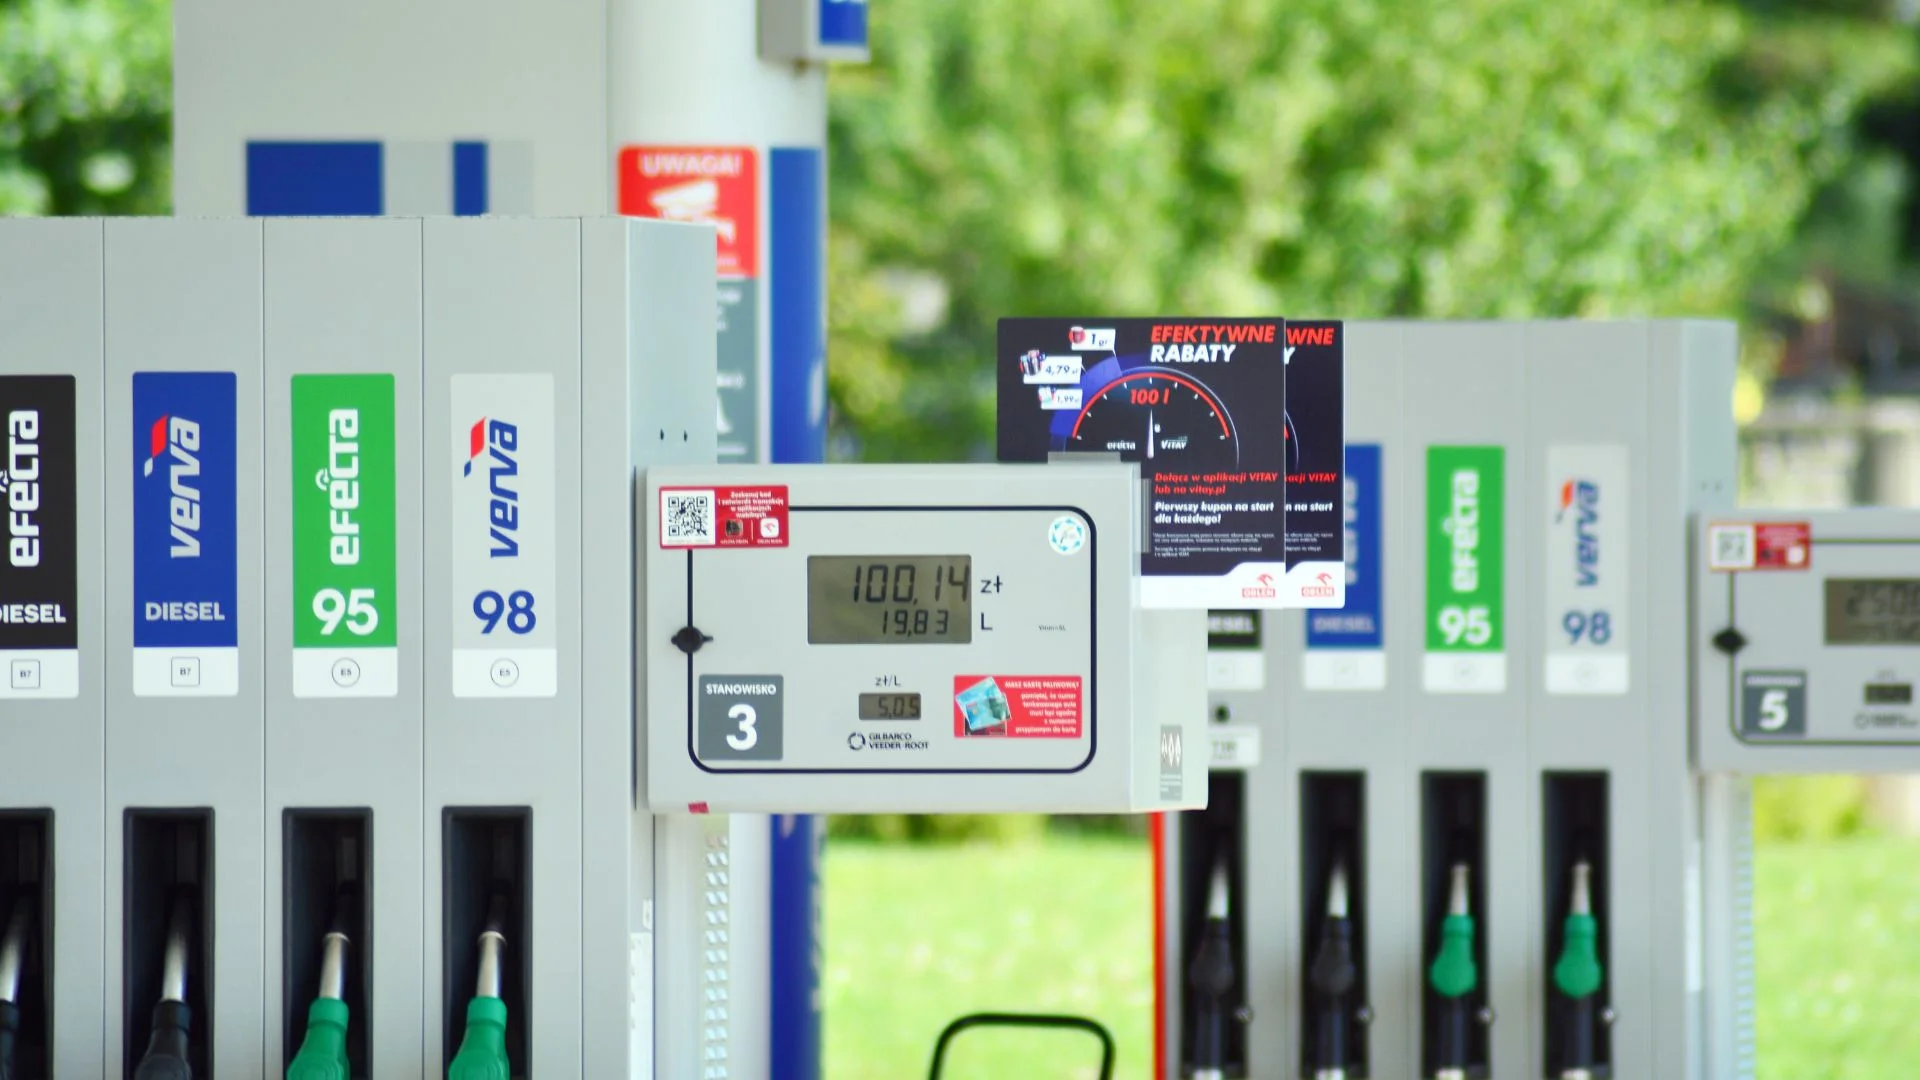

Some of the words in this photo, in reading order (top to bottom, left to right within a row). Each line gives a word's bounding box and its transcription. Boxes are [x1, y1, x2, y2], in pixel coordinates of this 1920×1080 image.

[641, 155, 741, 175] UWAGA!
[1091, 333, 1096, 345] 1
[1151, 325, 1276, 343] EFEKTYWNE
[1151, 344, 1236, 363] RABATY
[1045, 364, 1070, 376] 4,79
[1130, 388, 1159, 405] 100
[1191, 474, 1201, 482] w
[1203, 472, 1247, 484] aplikacji
[1249, 472, 1279, 482] VITAY
[1308, 472, 1337, 482] VITAY
[169, 416, 201, 559] verva
[488, 418, 519, 559] verva
[1155, 484, 1171, 494] lub
[1173, 486, 1187, 494] na
[1189, 484, 1226, 496] vitay.pl
[1155, 501, 1199, 514] Pierwszy
[1201, 501, 1233, 514] kupon
[1234, 503, 1249, 512] na
[1250, 501, 1275, 512] start
[1294, 503, 1308, 512] na
[1309, 501, 1333, 512] start
[1155, 513, 1172, 524] dla
[1174, 512, 1221, 526] każdego!
[1575, 481, 1599, 587] verva
[0, 603, 67, 624] IESEL
[145, 602, 226, 622] DIESEL
[312, 588, 379, 636] 95
[473, 590, 537, 635] 98
[980, 612, 993, 631] L
[882, 609, 949, 636] 19,83
[1312, 614, 1376, 634] DIESEL
[1438, 605, 1492, 646] 95
[1562, 610, 1613, 646] 98
[706, 683, 777, 696] STANOWISKO
[1758, 690, 1790, 730] 5
[725, 703, 758, 751] 3
